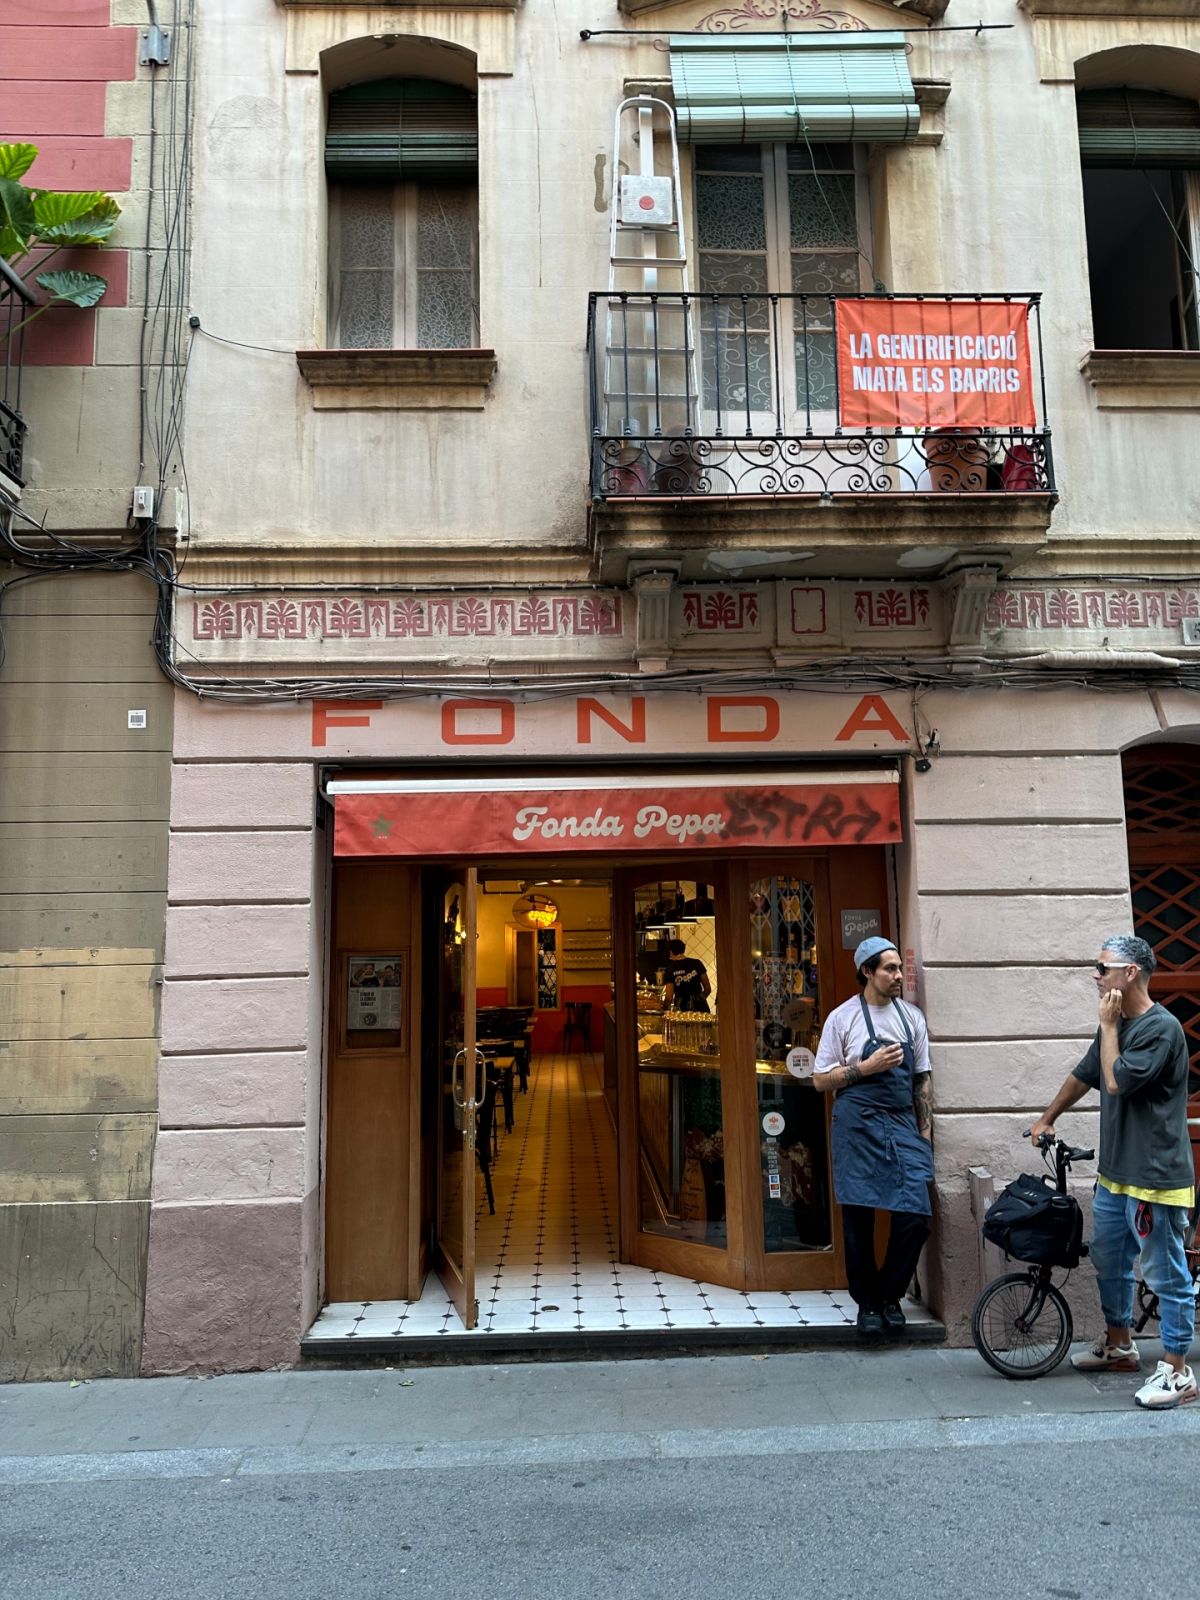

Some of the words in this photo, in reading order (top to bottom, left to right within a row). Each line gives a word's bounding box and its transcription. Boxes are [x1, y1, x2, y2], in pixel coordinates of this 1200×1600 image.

[849, 332, 873, 359] LA
[877, 330, 1018, 361] GENTRIFICACIÓ
[852, 366, 908, 392] MATA
[912, 366, 945, 393] ELS
[949, 366, 1021, 394] BARRIS
[312, 694, 911, 747] FONDA
[512, 805, 624, 841] Fonda
[633, 805, 726, 844] Pepa
[844, 918, 879, 937] Pepa
[674, 969, 698, 987] Pepa
